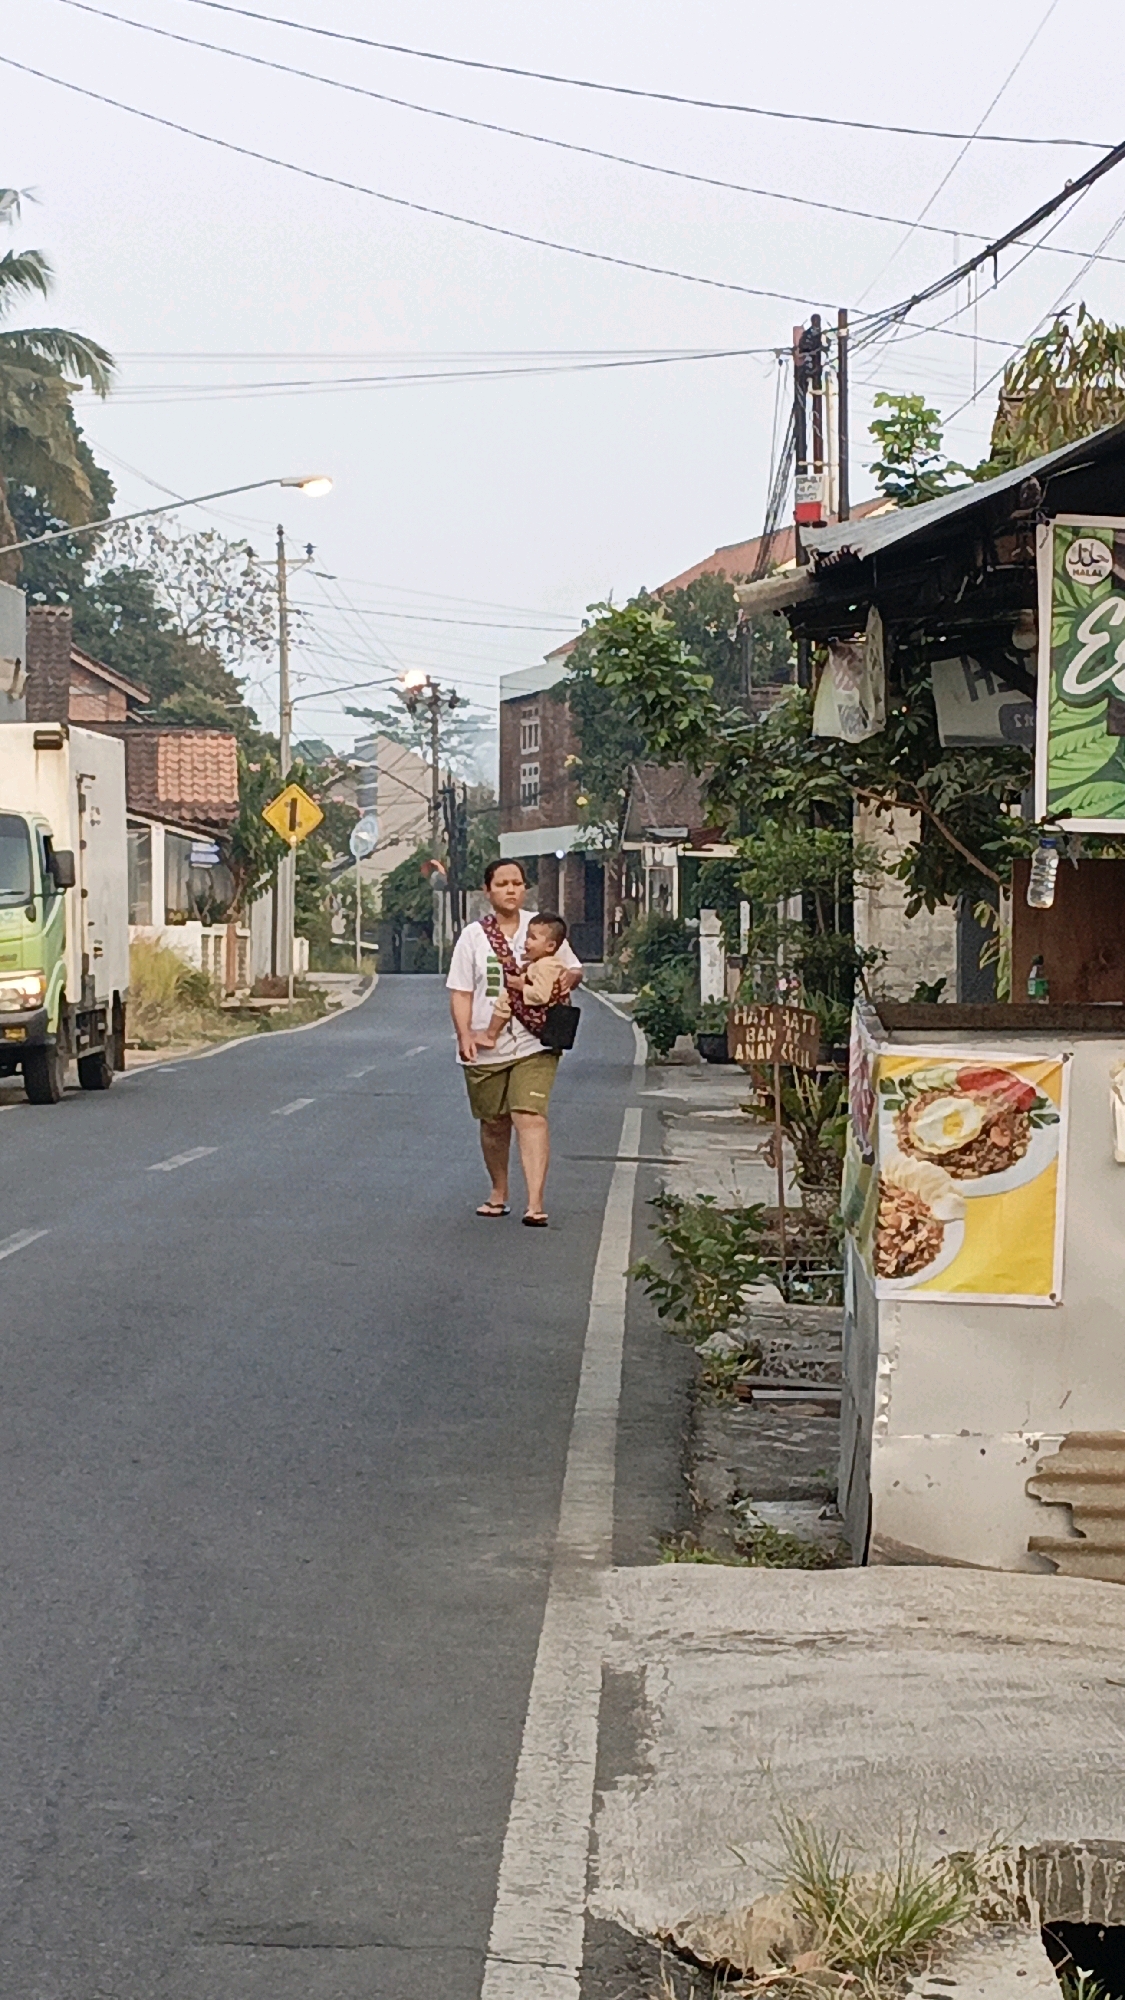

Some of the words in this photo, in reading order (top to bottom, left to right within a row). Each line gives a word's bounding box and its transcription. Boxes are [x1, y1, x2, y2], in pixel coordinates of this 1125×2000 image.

[1073, 569, 1103, 577] HALAL
[733, 1004, 774, 1026] HATI
[734, 1042, 775, 1060] ANAK
